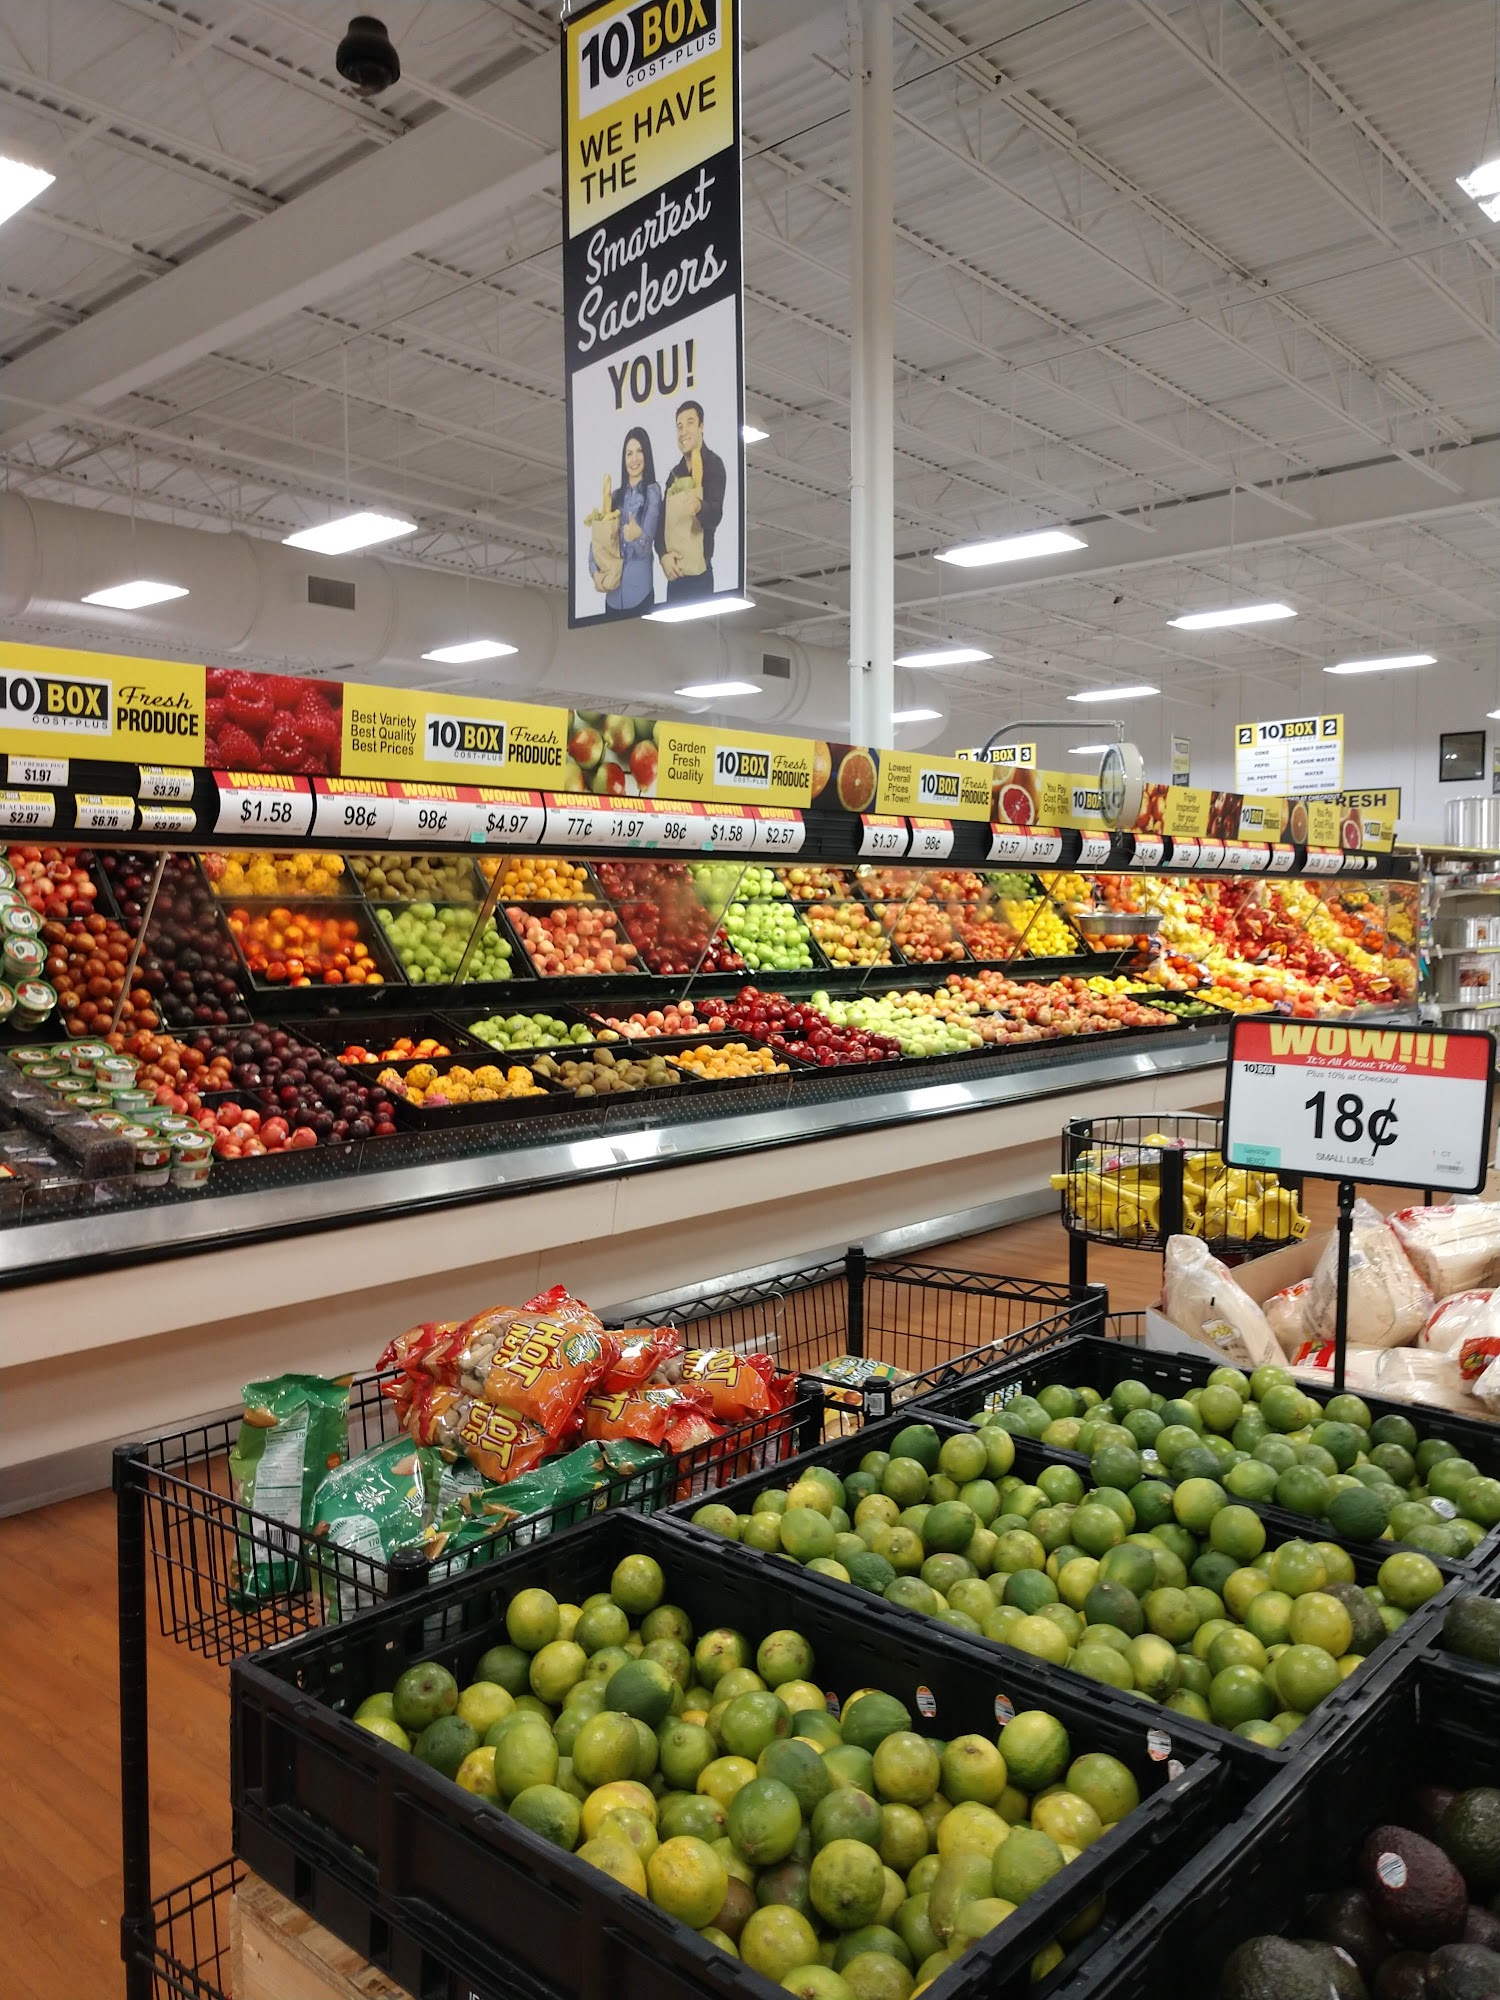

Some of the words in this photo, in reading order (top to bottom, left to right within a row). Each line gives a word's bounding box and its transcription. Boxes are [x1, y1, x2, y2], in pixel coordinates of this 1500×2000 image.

[581, 22, 623, 89] 10
[641, 0, 709, 59] BOX
[626, 32, 718, 88] COST-PLUS
[580, 121, 623, 168] WE
[633, 75, 718, 143] HAVE
[580, 154, 637, 204] THE
[586, 167, 716, 287] Smartest
[578, 242, 727, 353] Sackers
[607, 339, 696, 411] YOU!
[47, 683, 101, 716] BOX
[118, 685, 193, 711] Fresh
[32, 714, 109, 730] COST-PLUS
[116, 707, 199, 737] PRODUCE
[351, 710, 377, 725] Best
[380, 712, 417, 731] Variety
[351, 725, 377, 739] Best
[378, 728, 417, 745] Quality
[428, 721, 457, 749] 10
[463, 724, 500, 752] BOX
[510, 726, 559, 745] Fresh
[1240, 730, 1250, 744] 2
[1259, 725, 1280, 739] 10
[1285, 721, 1314, 737] BOX
[1324, 720, 1336, 735] 2
[351, 739, 377, 753] Best
[379, 741, 414, 756] Prices
[508, 743, 562, 767] PRODUCE
[668, 739, 706, 755] Garden
[992, 749, 1014, 762] BOX
[1022, 749, 1030, 760] 3
[454, 751, 503, 762] COST-PLUS
[673, 753, 701, 768] Fresh
[716, 751, 737, 775] 10
[740, 754, 768, 778] BOX
[773, 755, 808, 771] Fresh
[25, 768, 52, 782] $1.97
[667, 767, 704, 784] Quality
[887, 772, 911, 783] Overall
[888, 763, 912, 774] Lowest
[228, 772, 296, 791] WOW!!!
[326, 777, 388, 796] WOW!!!
[771, 770, 810, 789] PRODUCE
[888, 783, 909, 794] Prices
[921, 774, 935, 793] 10
[940, 778, 958, 796] BOX
[962, 777, 988, 789] Fresh
[153, 785, 180, 797] $3.29
[401, 782, 458, 800] WOW!!!
[478, 788, 531, 805] WOW!!!
[884, 793, 891, 801] in
[960, 790, 989, 805] PRODUCE
[1043, 793, 1056, 803] Cost
[1047, 783, 1056, 793] You
[1057, 784, 1067, 796] Pay
[553, 793, 601, 809] WOW!!!
[651, 800, 694, 814] WOW!!!
[1073, 791, 1085, 808] 10
[10, 811, 39, 824] $2.97
[240, 799, 292, 823] $1.58
[344, 806, 377, 830] 98¢
[1043, 803, 1056, 815] Only
[91, 814, 119, 827] $6.76
[417, 810, 448, 834] 98¢
[486, 813, 528, 833] $4.97
[567, 818, 592, 839] 77¢
[664, 822, 687, 842] 98¢
[711, 823, 743, 842] $1.58
[766, 827, 794, 845] $2.57
[872, 833, 898, 849] $1.37
[924, 836, 941, 852] 98¢
[998, 841, 1019, 854] $1.57
[1032, 843, 1054, 856] $1.37
[1269, 1023, 1449, 1070] WOW!!!
[1243, 1063, 1255, 1074] 10
[1256, 1065, 1275, 1075] BOX
[1306, 1055, 1326, 1065] It's
[1327, 1057, 1343, 1066] All
[1343, 1059, 1376, 1069] About
[1378, 1061, 1408, 1072] Price
[1306, 1070, 1325, 1078] Plus
[1328, 1071, 1346, 1080] 10%
[1358, 1073, 1399, 1084] Checkout
[1305, 1091, 1399, 1157] 18¢
[1316, 1152, 1345, 1163] SMALL
[1346, 1156, 1375, 1167] LIMES
[491, 1322, 531, 1367] NUTS
[508, 1322, 569, 1389] HOT
[704, 1348, 738, 1387] OT
[368, 1537, 380, 1547] 170
